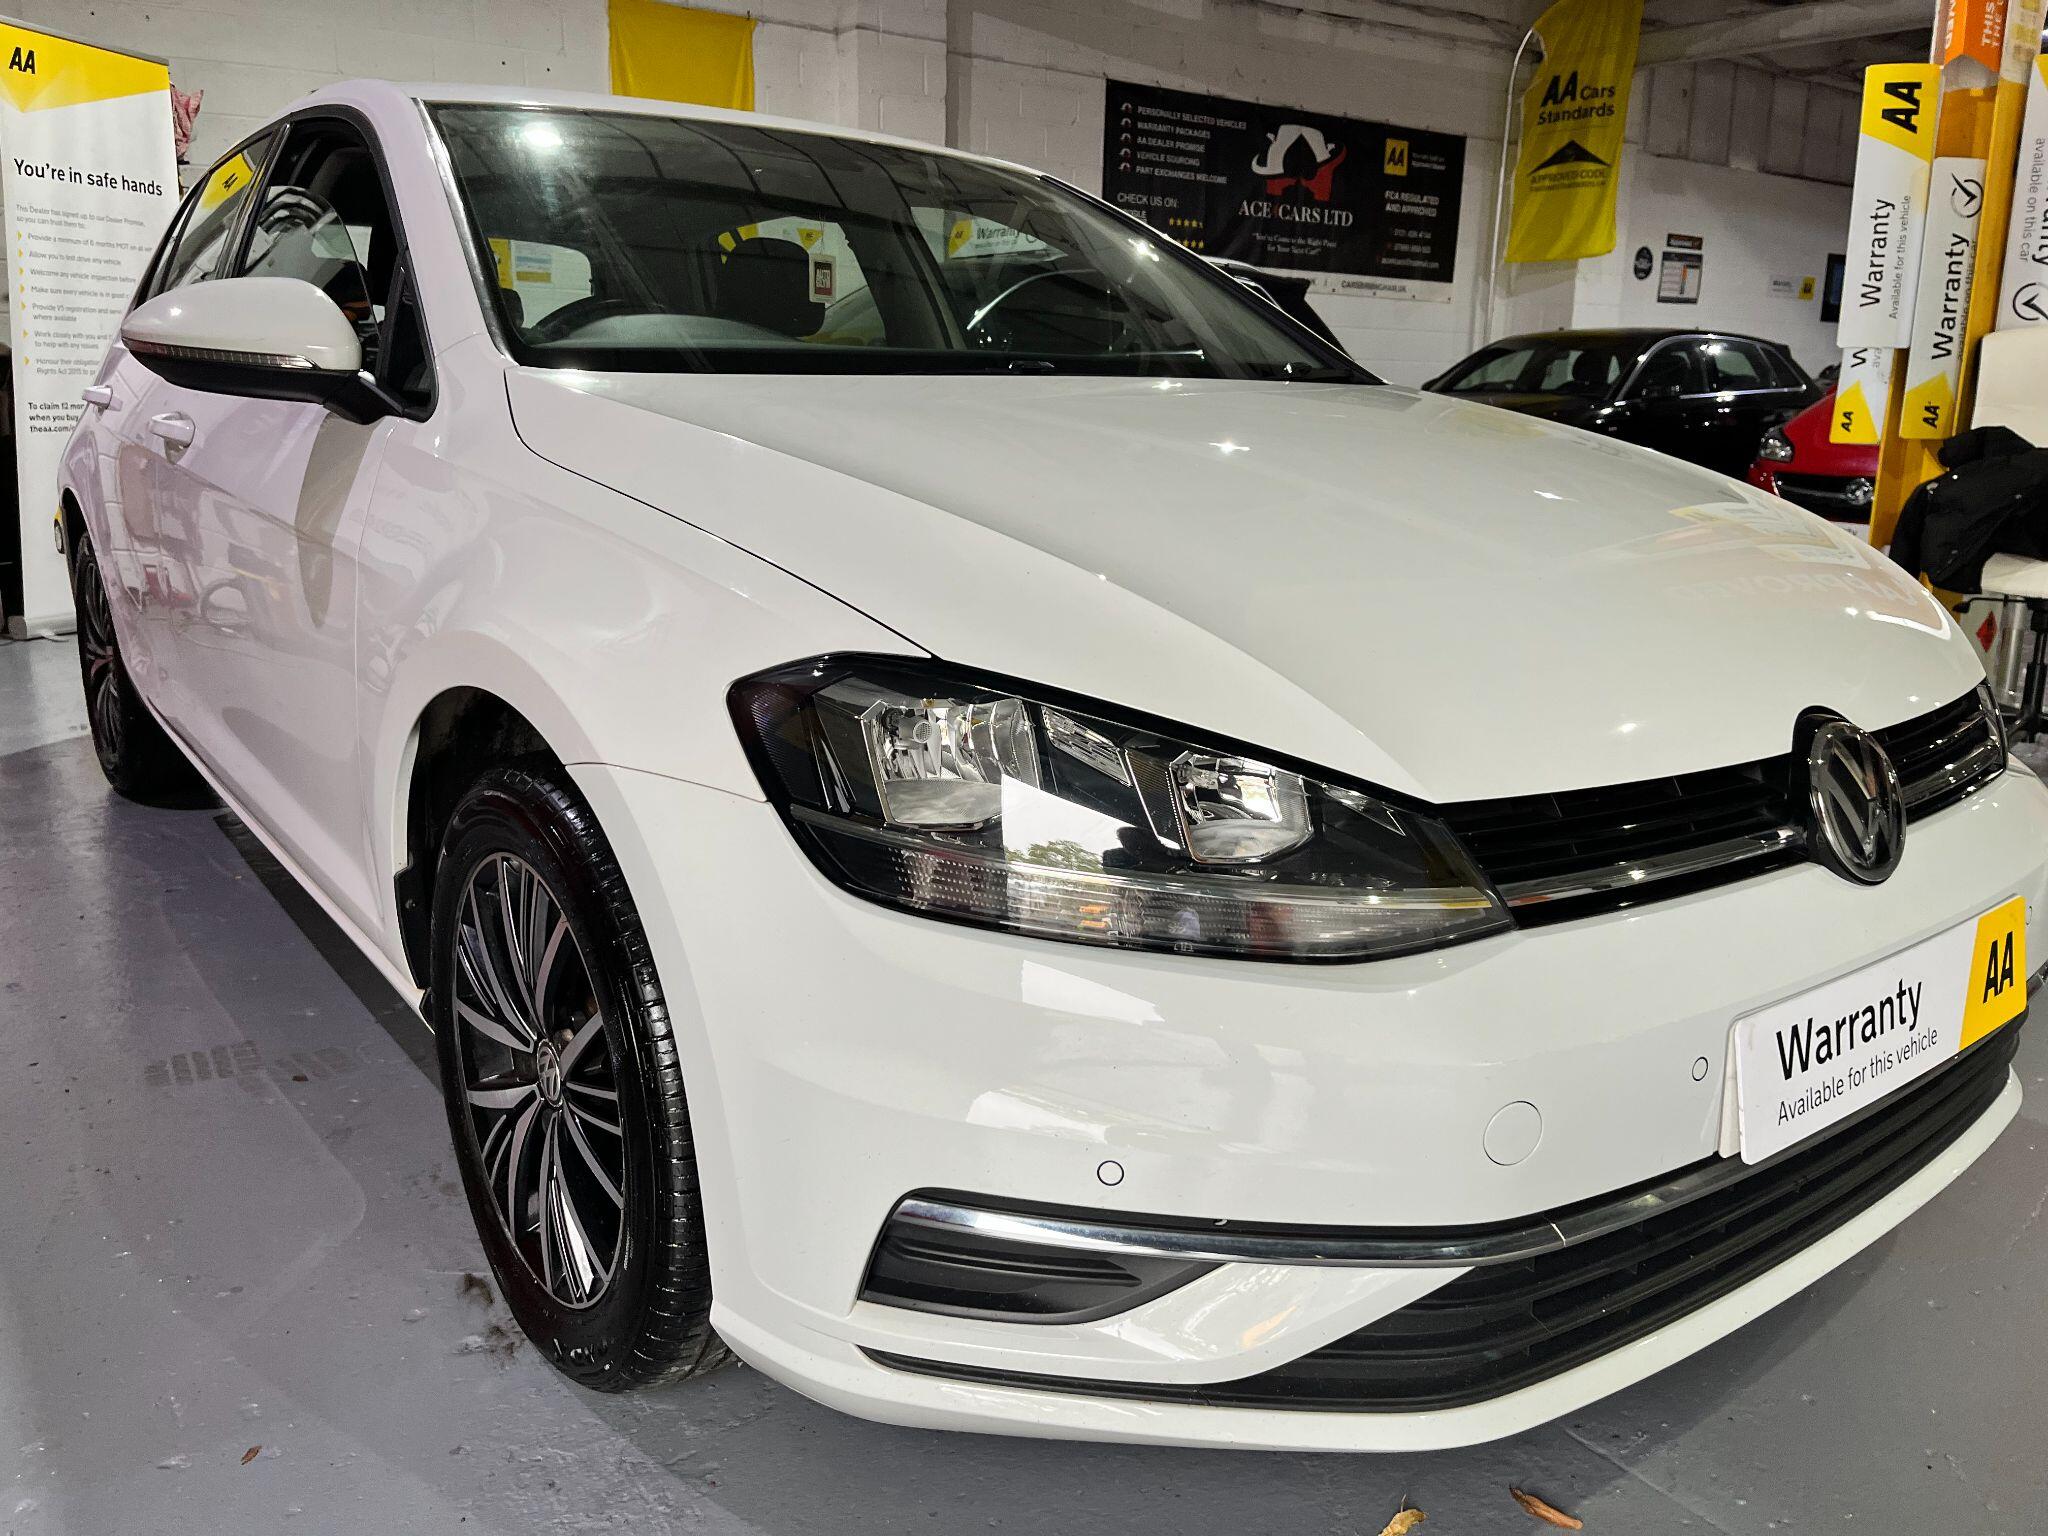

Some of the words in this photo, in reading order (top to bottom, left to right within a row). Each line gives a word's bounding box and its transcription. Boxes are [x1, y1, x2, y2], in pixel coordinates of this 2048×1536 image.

[9, 46, 36, 75] AA
[1540, 70, 1578, 107] AA
[1580, 85, 1615, 100] Cars
[1538, 102, 1615, 125] Standards
[1882, 82, 1922, 134] AA
[14, 158, 66, 181] You're
[69, 166, 82, 184] in
[87, 172, 118, 189] safe
[121, 175, 163, 196] hands
[2029, 137, 2046, 193] available
[1117, 192, 1149, 206] CHECK
[1150, 196, 1162, 206] US
[1238, 200, 1272, 218] ACE
[1278, 204, 1321, 223] CARS
[1324, 209, 1353, 227] LTD
[1901, 195, 1911, 231] vehicle
[2028, 196, 2037, 213] on
[2022, 215, 2037, 238] this
[1860, 199, 1895, 307] Warranty
[1897, 234, 1907, 253] this
[2020, 242, 2030, 262] car
[1894, 255, 1904, 270] for
[1889, 273, 1902, 319] Available
[1931, 233, 1969, 360] Warranty
[28, 402, 38, 410] To
[40, 402, 60, 410] claim
[62, 402, 69, 410] 12
[1922, 405, 1940, 429] AA
[1841, 411, 1854, 433] AA
[1983, 931, 2013, 1004] AA
[1776, 979, 1922, 1080] Warranty
[1778, 1073, 1844, 1126] Available
[1849, 1065, 1867, 1090] for
[1869, 1051, 1893, 1079] this
[1896, 1027, 1938, 1064] vehicle
